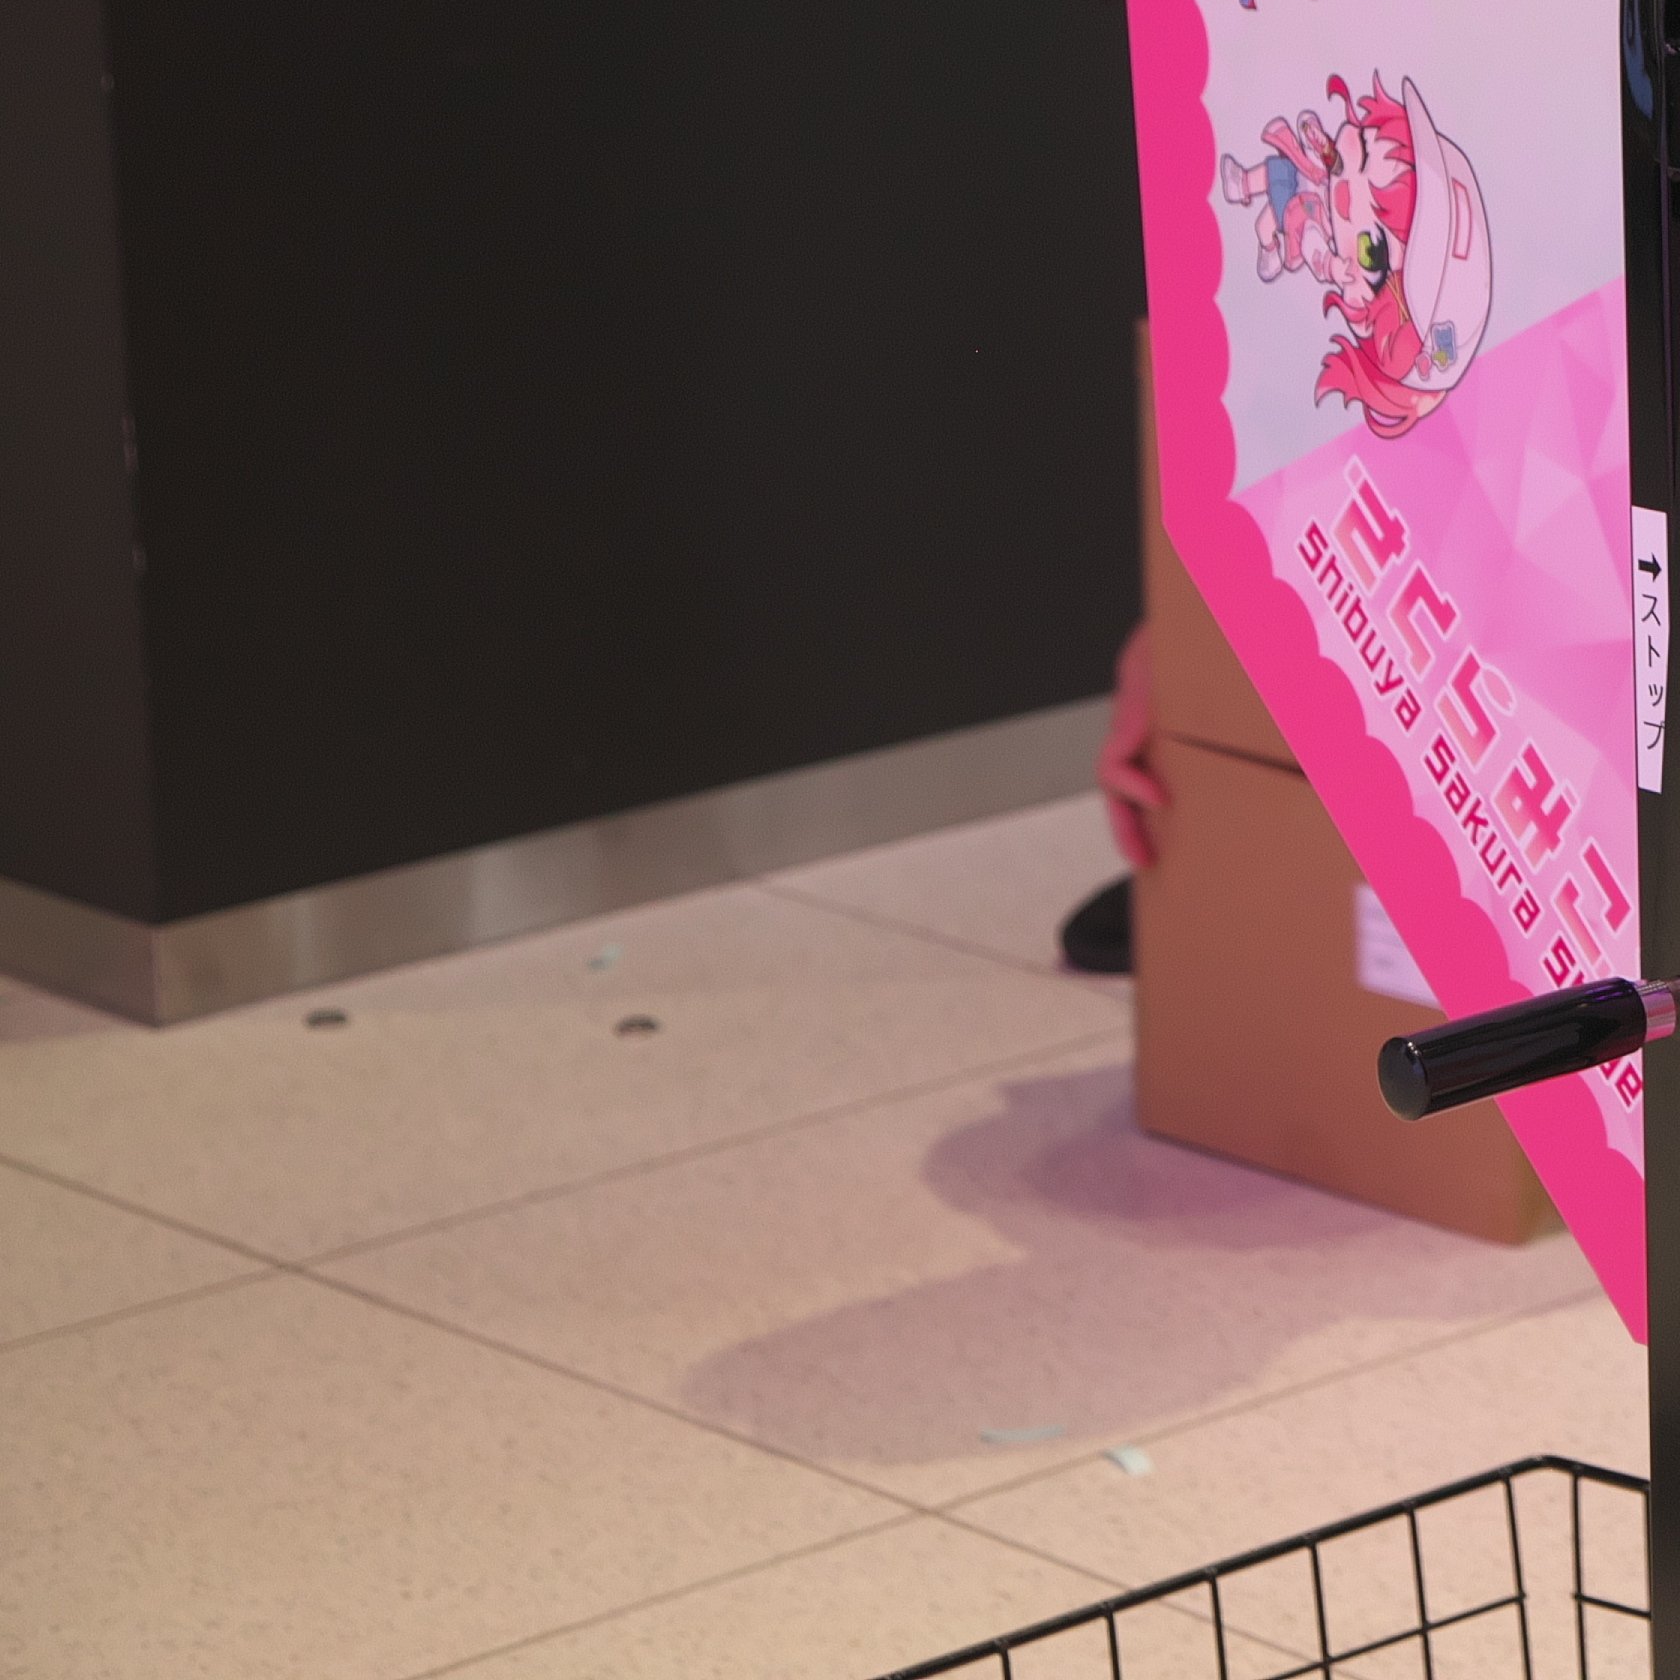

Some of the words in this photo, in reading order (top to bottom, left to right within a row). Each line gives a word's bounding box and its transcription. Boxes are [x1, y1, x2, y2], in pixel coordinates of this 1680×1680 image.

[1298, 521, 1422, 732] Shibuya
[1423, 734, 1542, 933] Sakura
[1641, 592, 1666, 751] ストップ
